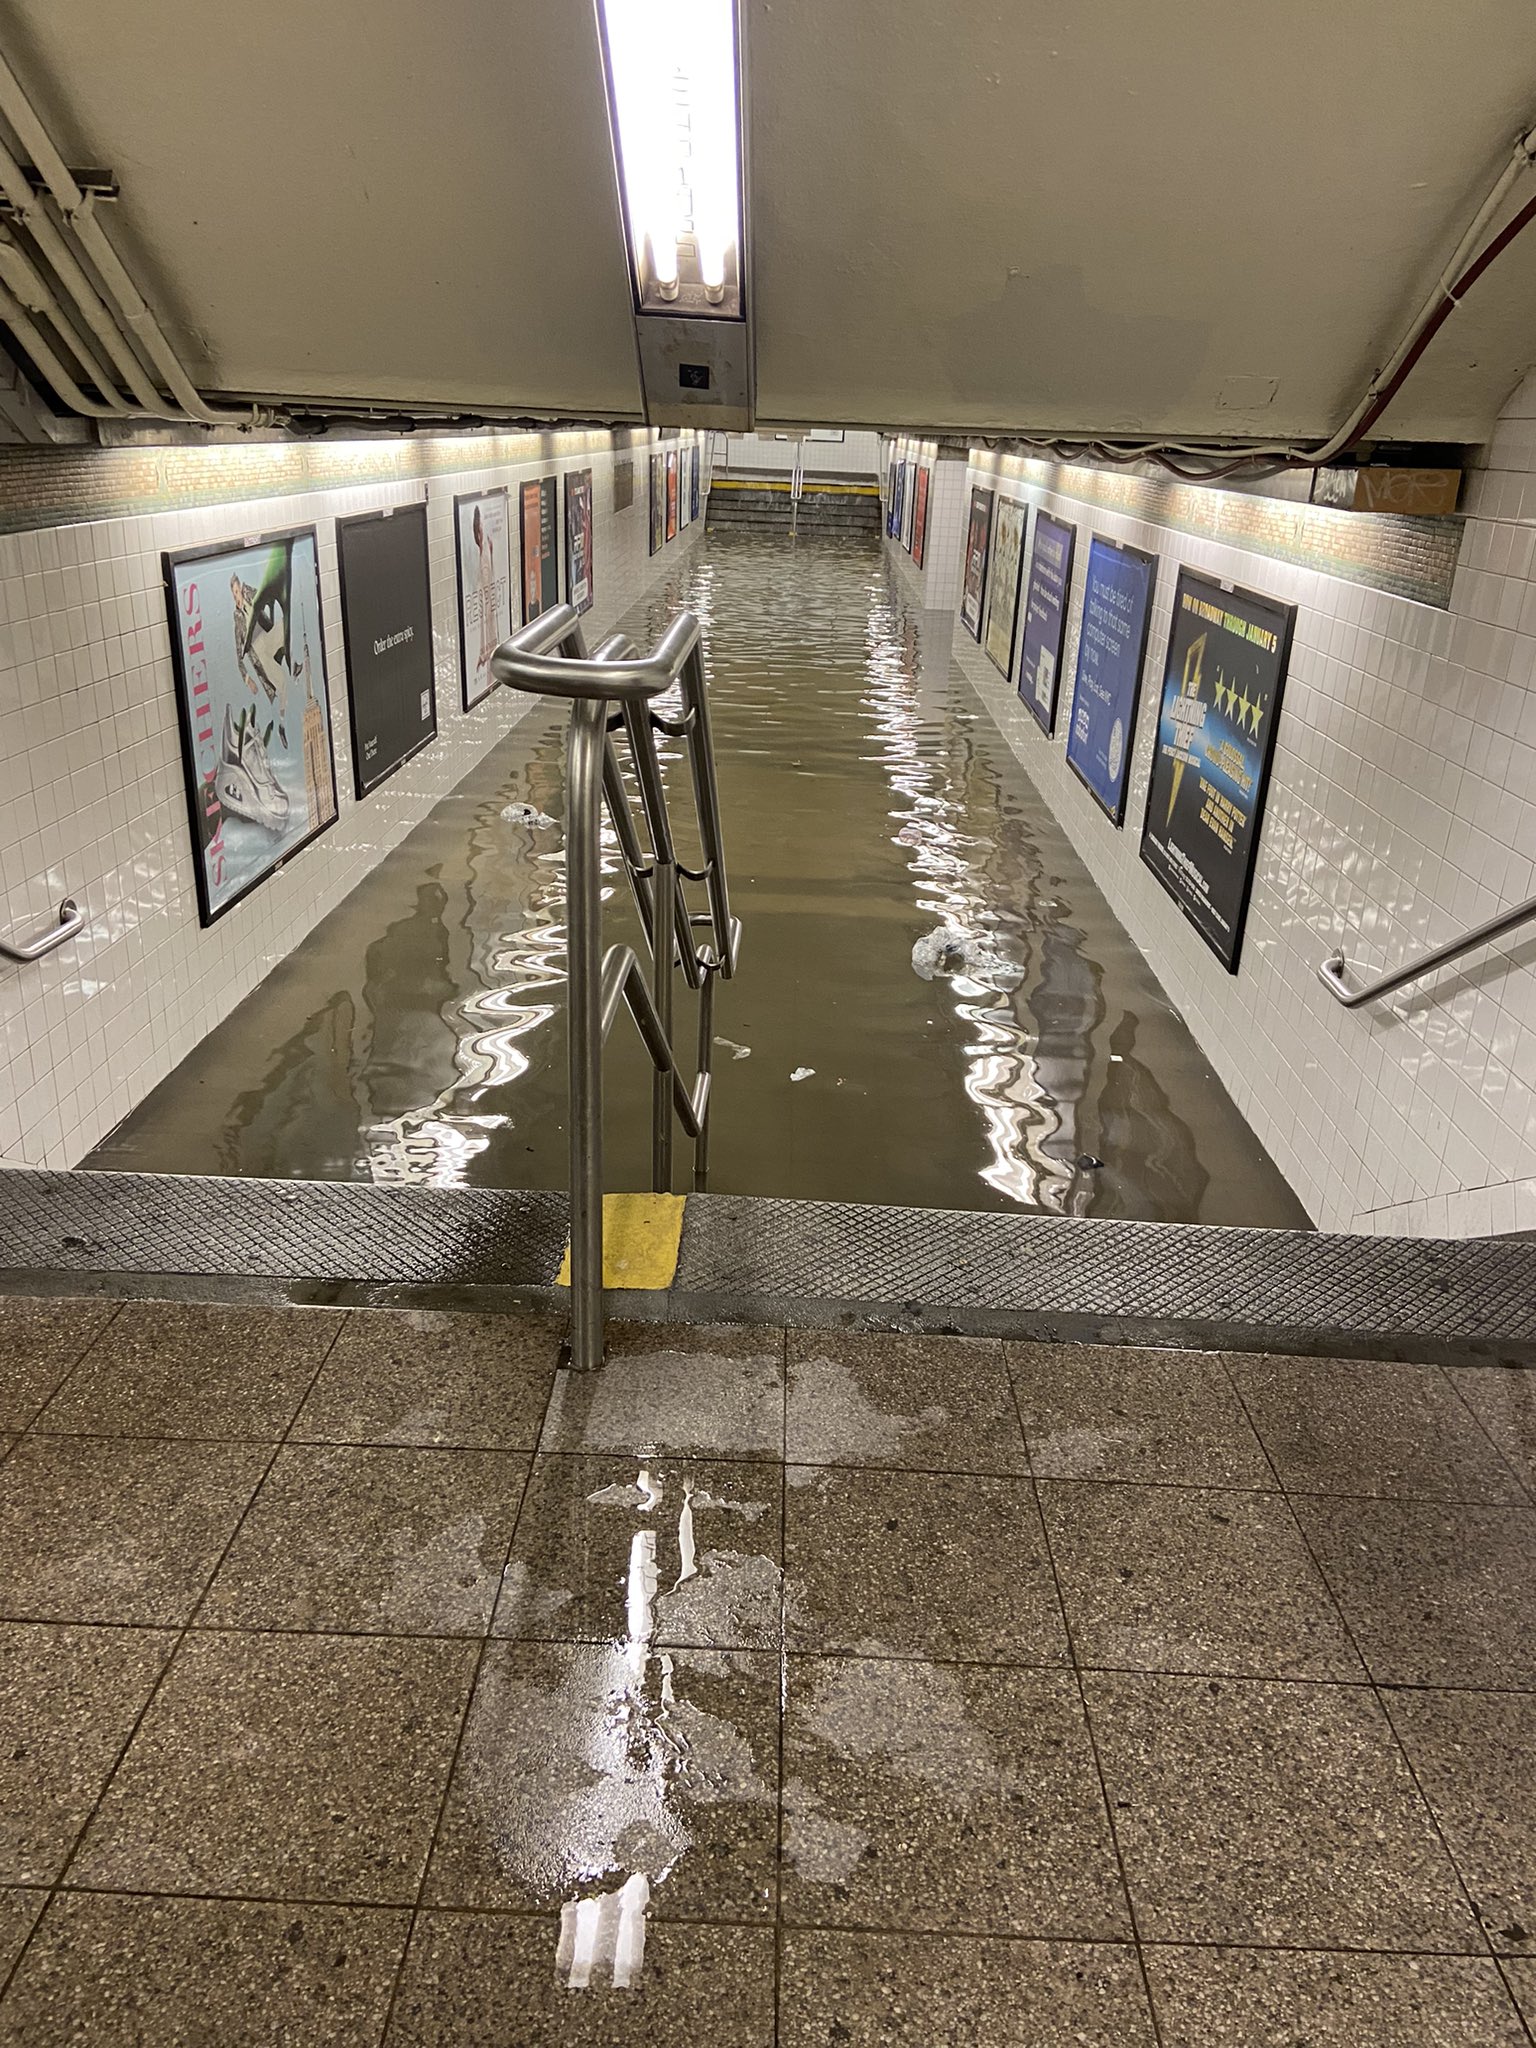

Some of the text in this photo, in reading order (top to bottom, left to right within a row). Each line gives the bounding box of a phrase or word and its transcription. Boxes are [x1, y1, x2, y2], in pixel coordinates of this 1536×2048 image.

[465, 576, 506, 627] RESPECT
[374, 638, 387, 655] Order
[394, 631, 404, 645] extra
[1199, 601, 1224, 626] BROADWAY
[1223, 612, 1247, 638] THROUGH
[1246, 623, 1272, 650] JANUARY
[1271, 634, 1277, 653] 5
[1187, 681, 1197, 697] THE
[1169, 695, 1207, 729] LIGHTNING
[184, 582, 228, 888] SKECHERS
[1174, 722, 1194, 749] THIEF
